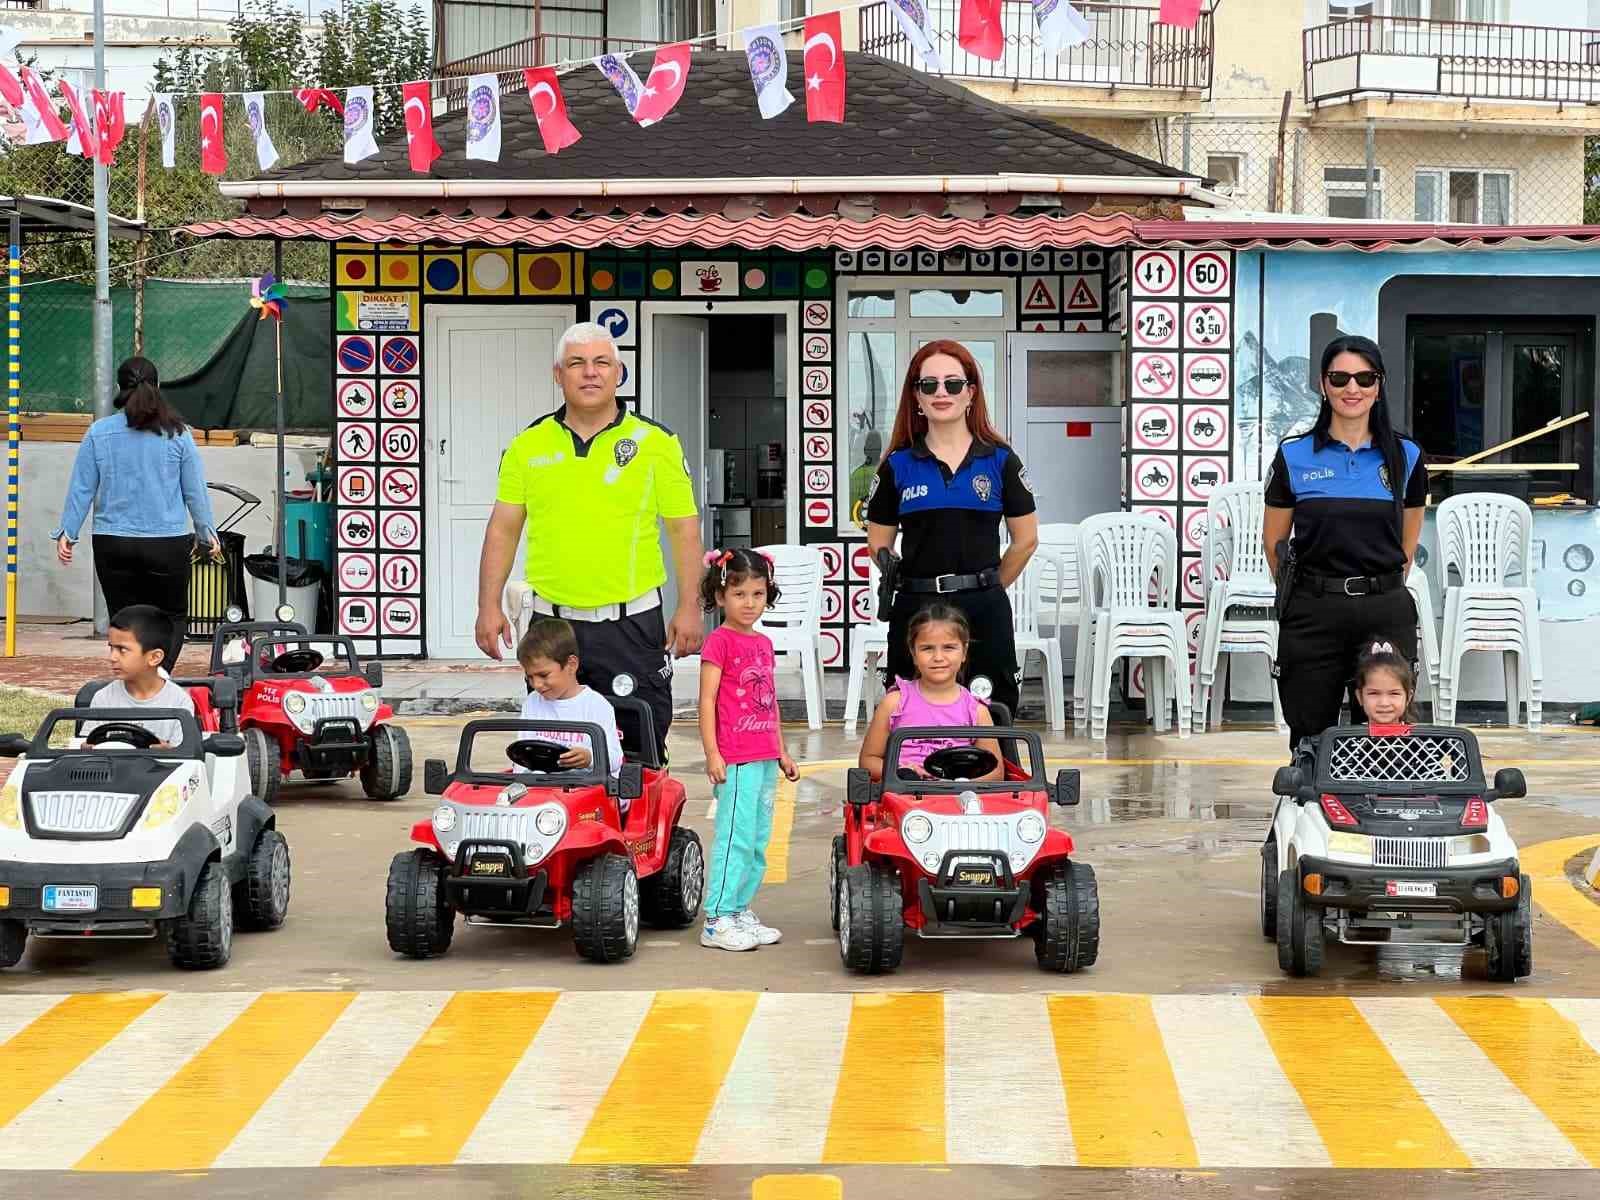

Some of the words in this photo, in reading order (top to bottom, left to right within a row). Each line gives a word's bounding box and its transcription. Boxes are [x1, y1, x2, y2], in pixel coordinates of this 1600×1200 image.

[695, 264, 719, 280] cafe
[1195, 264, 1218, 284] 50
[388, 434, 411, 453] 50
[474, 860, 504, 873] Snappy
[959, 871, 991, 884] Snappy
